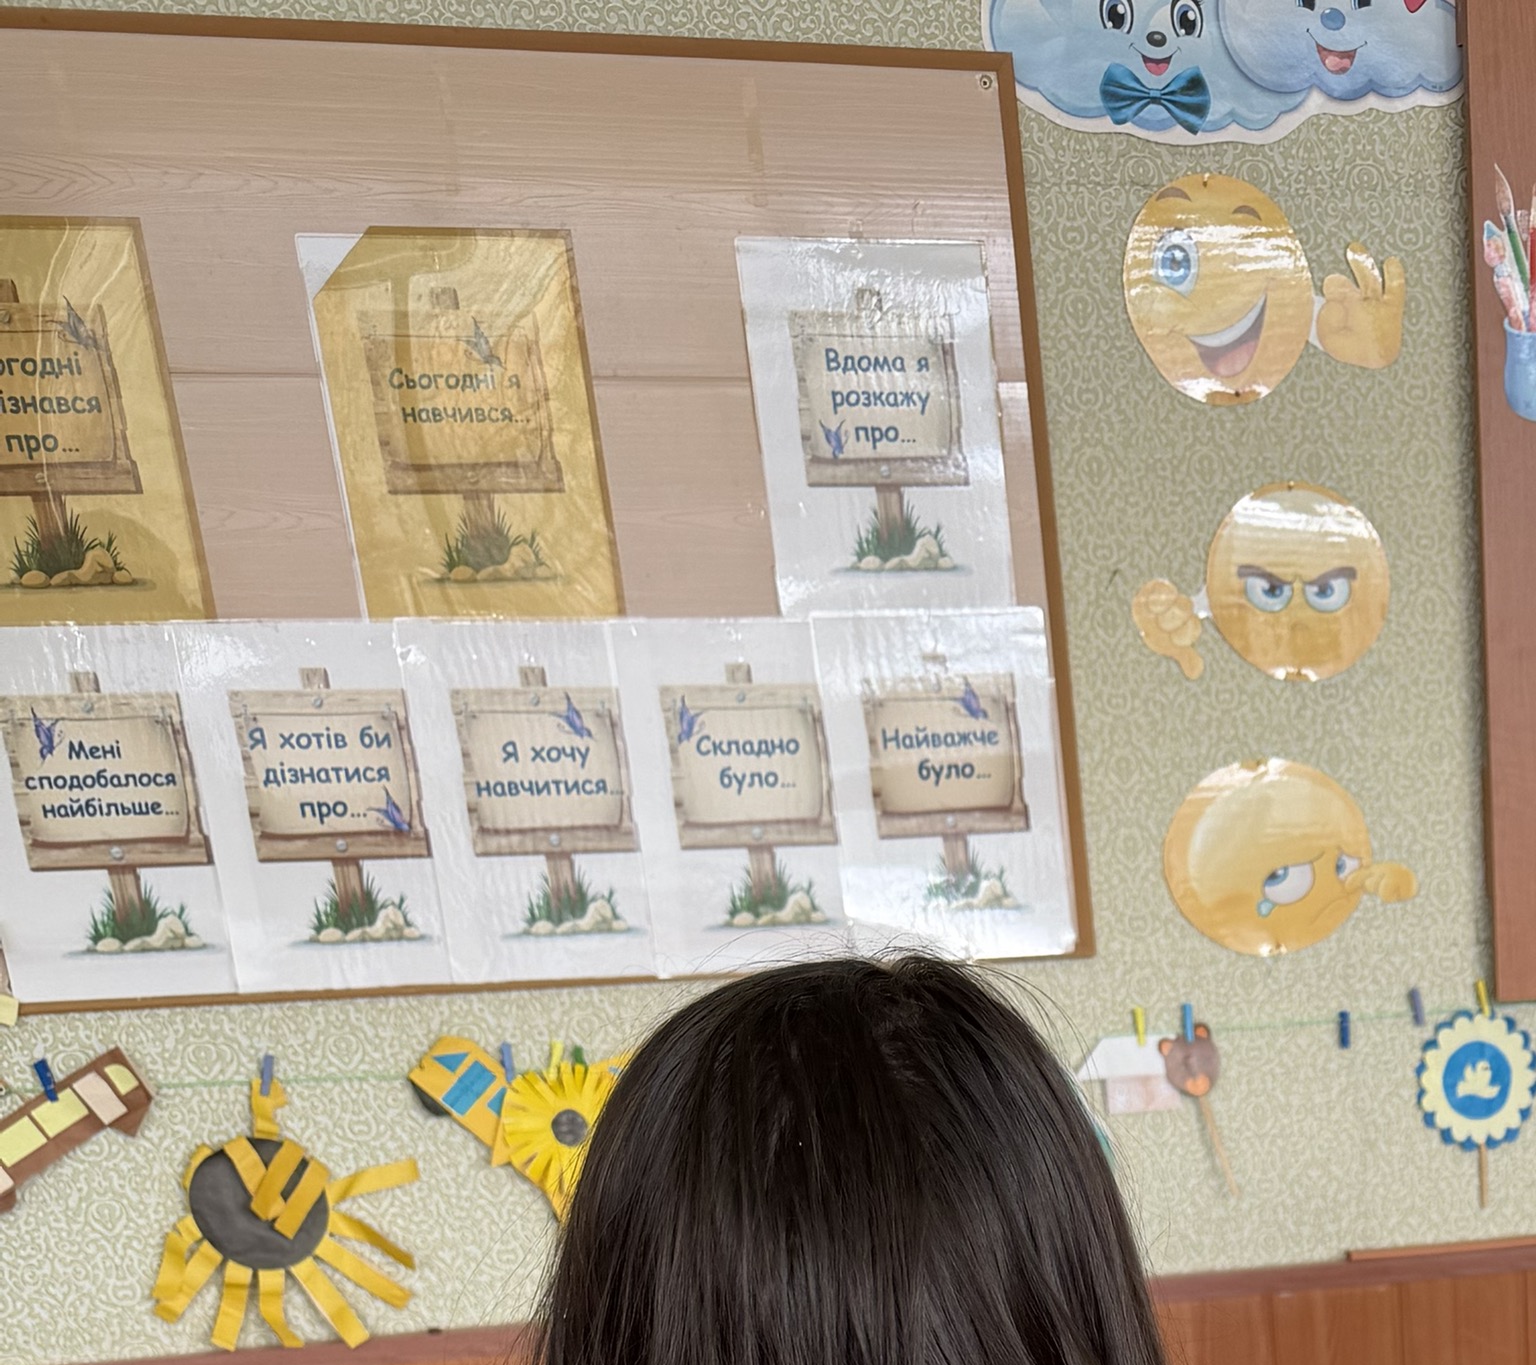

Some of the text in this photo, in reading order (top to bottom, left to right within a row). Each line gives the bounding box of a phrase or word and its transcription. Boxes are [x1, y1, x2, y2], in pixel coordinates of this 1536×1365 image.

[824, 347, 930, 374] Вдома я
[388, 367, 521, 392] Сьогодні я
[831, 390, 931, 415] розкажу
[402, 407, 531, 424] навчився...
[5, 433, 80, 460] про...
[854, 425, 916, 450] про...
[68, 739, 122, 761] Мені
[248, 725, 392, 750] Я хотів би
[696, 735, 800, 758] Складно
[881, 726, 999, 750] Найважче
[502, 740, 591, 769] Я хочу
[25, 768, 177, 792] сподобалося
[263, 762, 391, 788] дізнатися
[719, 766, 796, 795] було...
[918, 758, 992, 787] було...
[475, 778, 625, 798] навчитися...
[42, 797, 180, 819] найбільше...
[300, 800, 367, 825] про...
